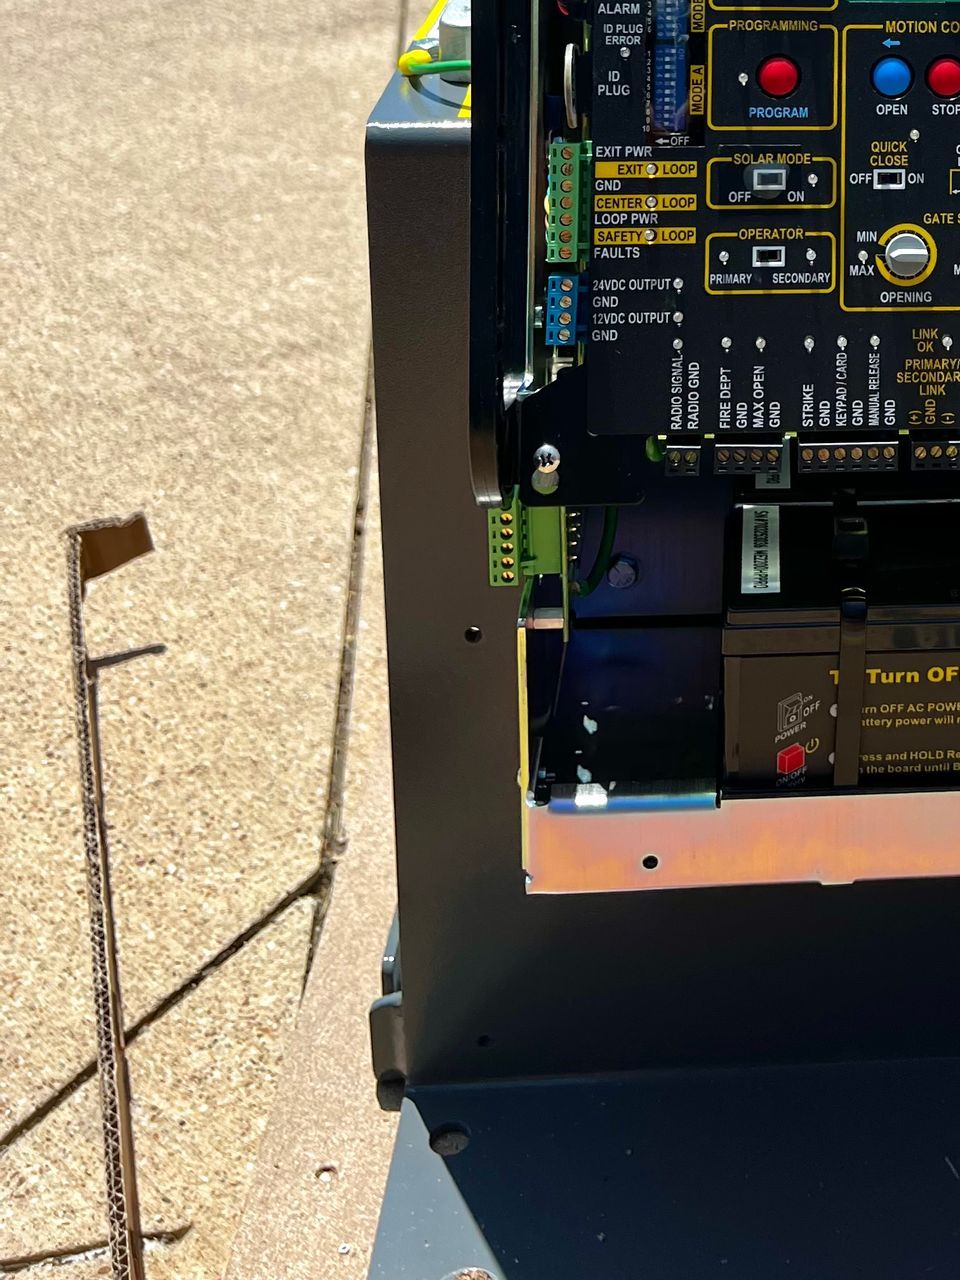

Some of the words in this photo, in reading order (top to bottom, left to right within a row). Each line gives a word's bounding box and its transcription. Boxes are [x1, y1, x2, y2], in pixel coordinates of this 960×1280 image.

[598, 4, 640, 14] ALARM
[604, 25, 614, 33] ID
[616, 25, 643, 33] PLUG
[730, 21, 818, 31] PROGRAMMING
[886, 21, 937, 33] MOTION
[606, 36, 641, 45] ERROR
[749, 108, 809, 118] PROGRAM
[876, 104, 908, 115] OPEN
[596, 147, 622, 157] EXIT
[625, 147, 652, 157] PWR
[871, 142, 907, 153] QUICK
[734, 154, 774, 164] SOLAR
[777, 154, 811, 164] MODE
[870, 155, 908, 166] CLOSE
[618, 164, 643, 175] EXIT
[663, 164, 695, 174] LOOP
[596, 198, 642, 208] CENTER
[662, 198, 694, 208] LOOP
[923, 213, 953, 224] GATE
[739, 229, 803, 240] OPERATOR
[594, 247, 640, 258] FAULTS
[710, 274, 752, 284] PRIMARY
[772, 273, 831, 284] SECONDARY
[592, 280, 626, 291] 24VDC
[628, 279, 671, 290] OUTPUT
[836, 352, 847, 377] CARD
[672, 354, 683, 392] SIGNAL
[720, 367, 731, 400] DEPT
[803, 384, 814, 426] STRIKE
[836, 388, 847, 426] KEYPAD
[671, 396, 683, 430] RADIO
[720, 403, 730, 429] FIRE
[866, 669, 920, 684] Turn
[880, 705, 903, 713] OFF
[907, 704, 924, 712] AC
[896, 718, 930, 728] power
[935, 716, 954, 724] will
[775, 722, 806, 743] POWER
[885, 752, 907, 761] and
[910, 751, 943, 759] HOLD
